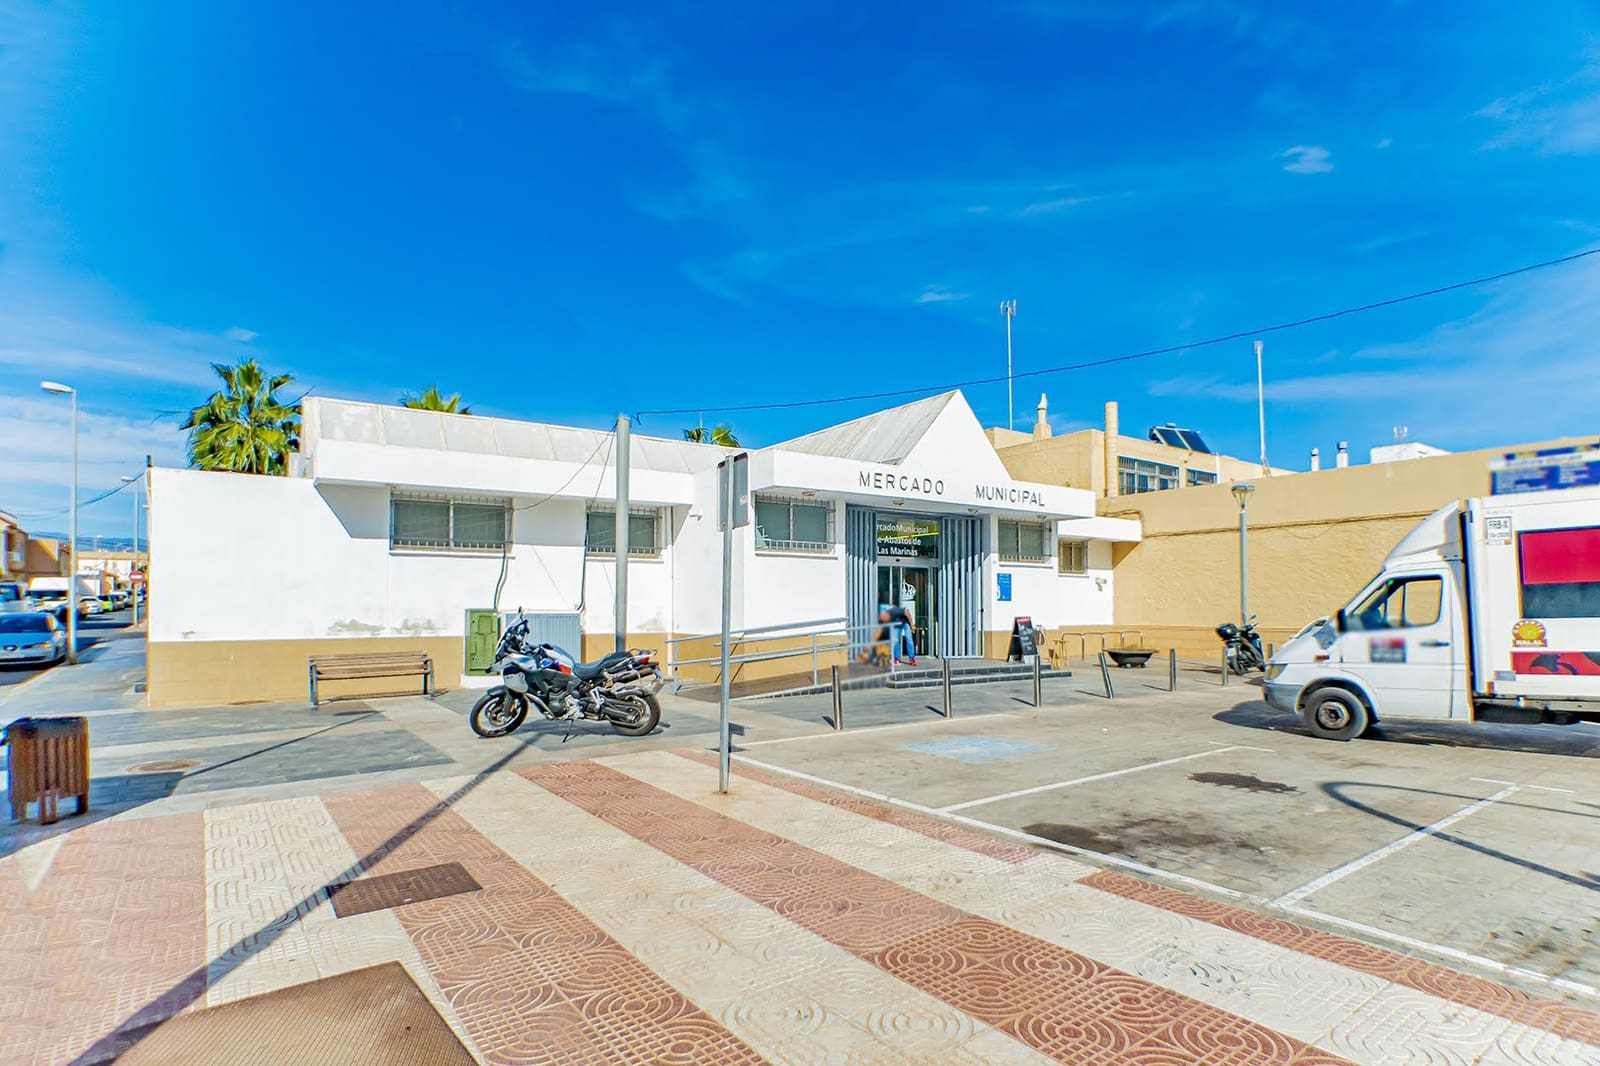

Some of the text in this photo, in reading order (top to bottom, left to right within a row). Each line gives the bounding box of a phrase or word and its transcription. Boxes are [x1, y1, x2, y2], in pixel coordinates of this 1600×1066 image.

[859, 471, 1045, 507] MERCADO MUNICIPAL
[877, 546, 918, 556] Las Marinas
